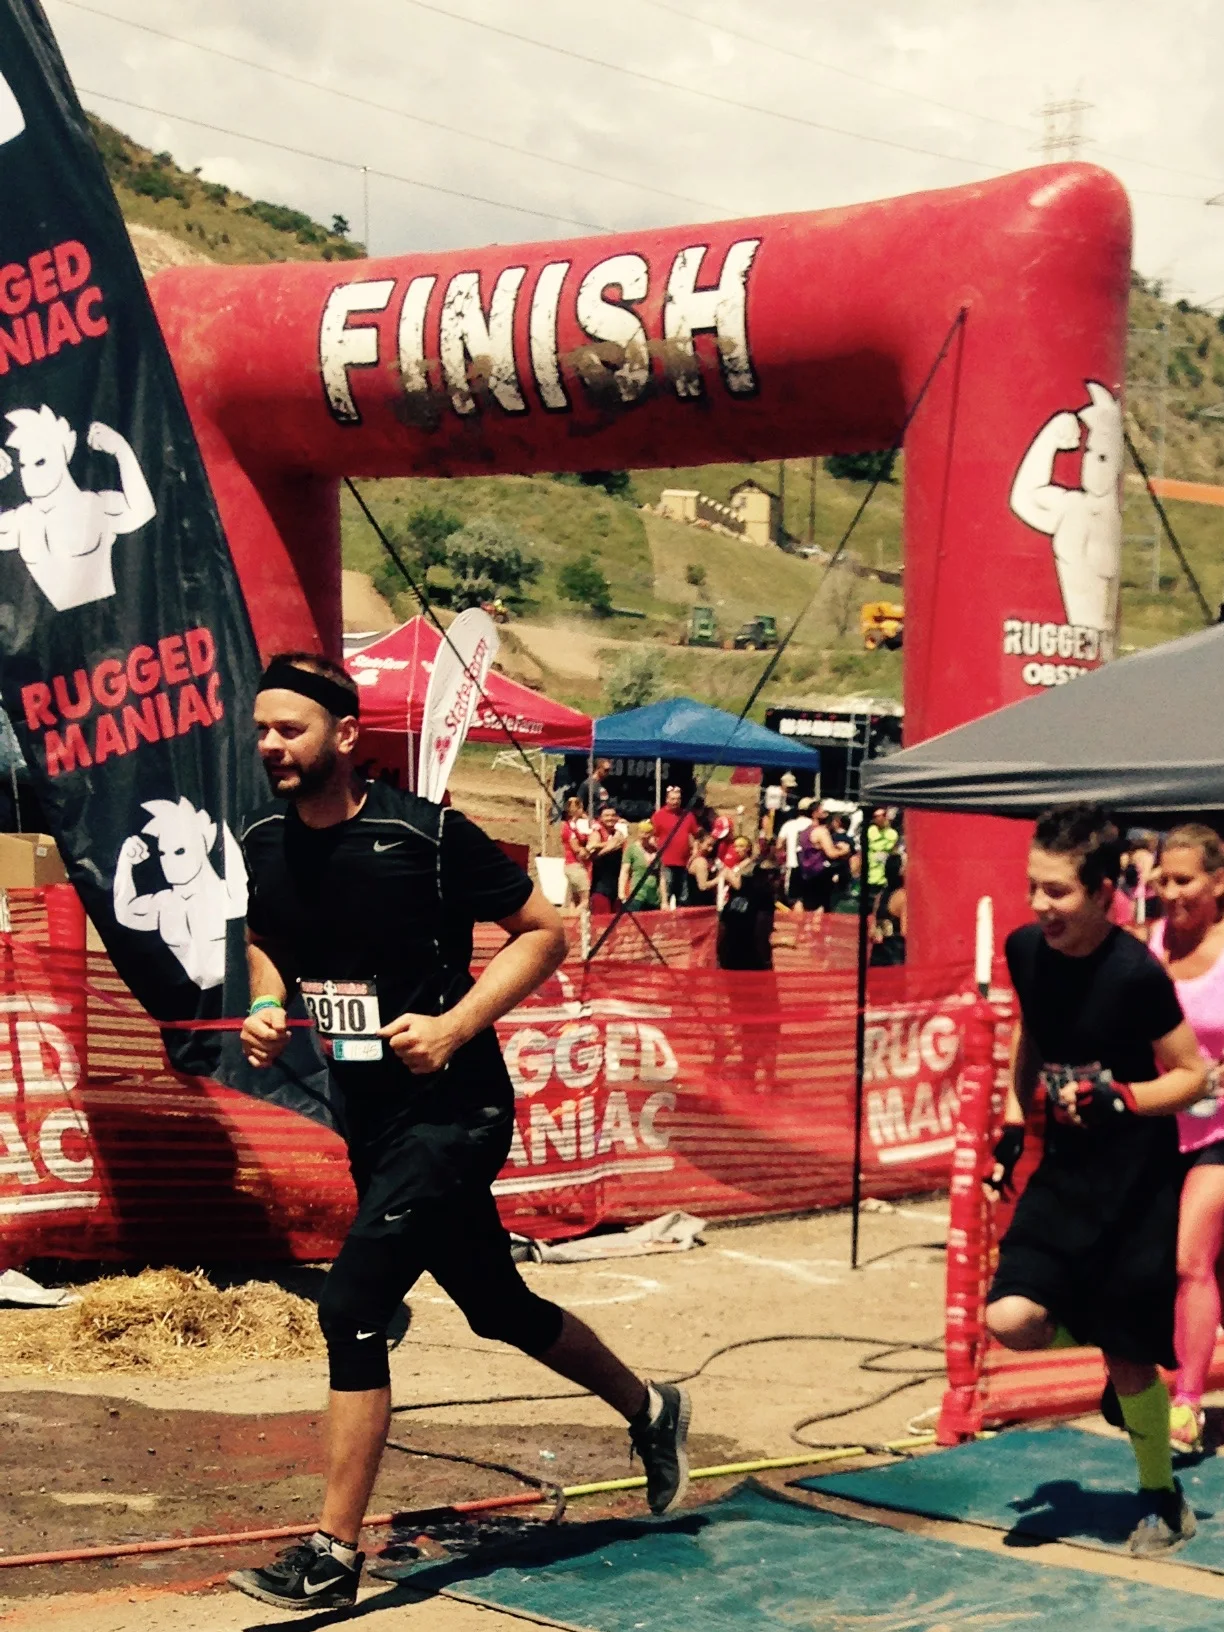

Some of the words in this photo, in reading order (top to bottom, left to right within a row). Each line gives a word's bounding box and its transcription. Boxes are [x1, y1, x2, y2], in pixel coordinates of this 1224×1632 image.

[319, 237, 762, 424] FINISH
[21, 626, 216, 731] RUGGED
[44, 671, 224, 777] MANIAC
